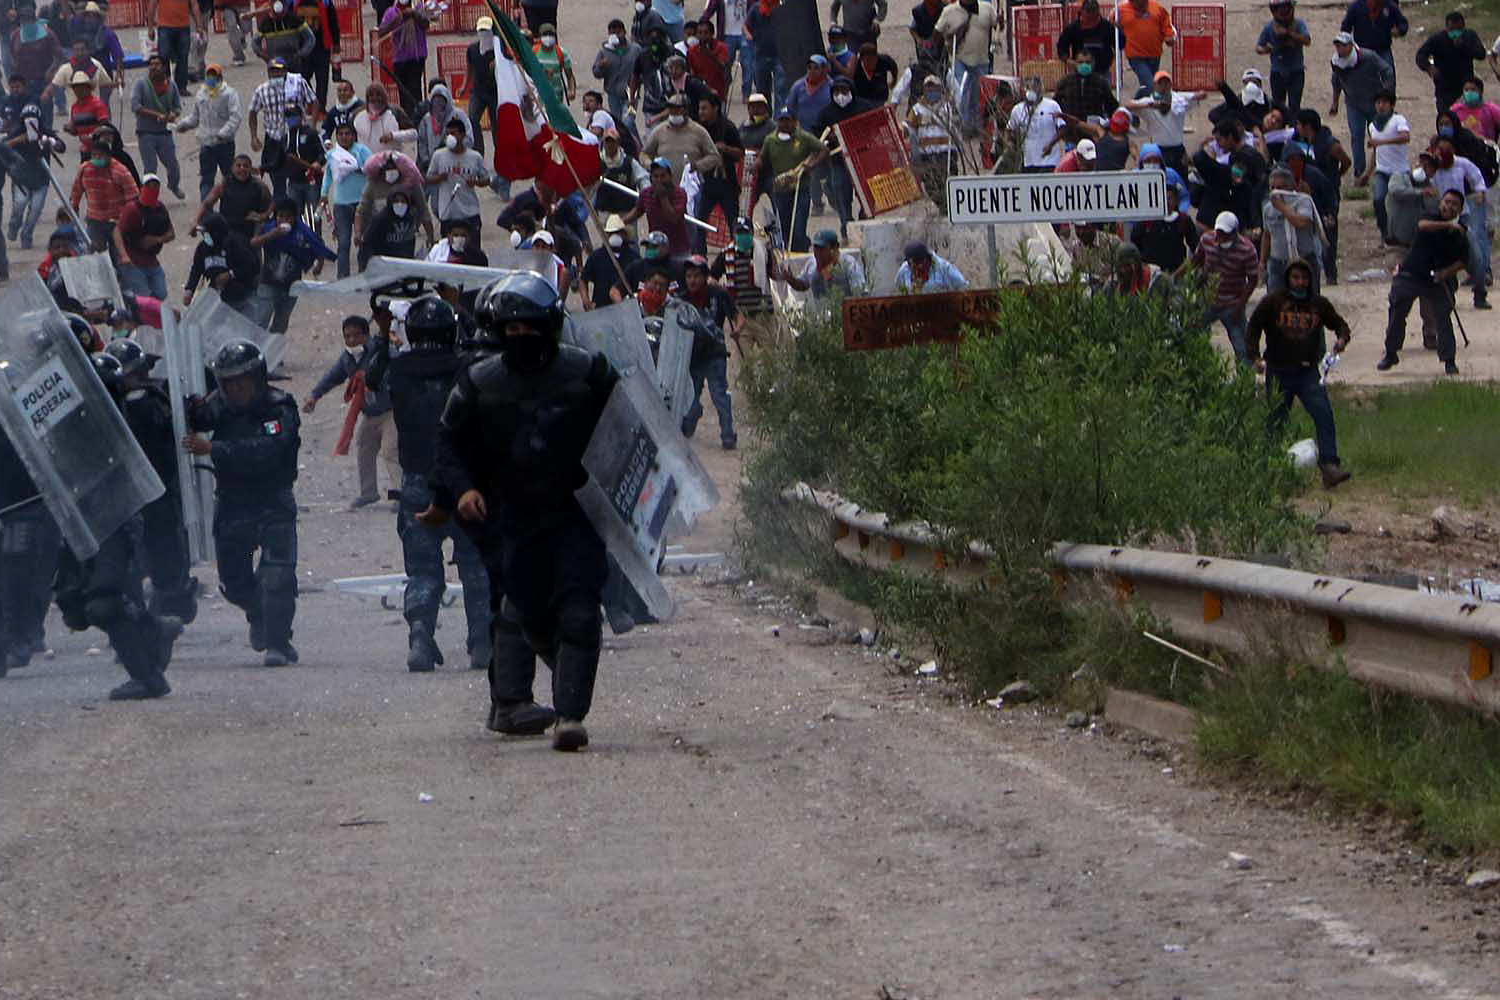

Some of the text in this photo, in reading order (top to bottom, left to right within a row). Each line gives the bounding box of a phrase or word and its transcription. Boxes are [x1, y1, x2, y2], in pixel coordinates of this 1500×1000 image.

[955, 182, 1159, 214] PUENTE NOCHIXTLAN II
[21, 371, 63, 411] POLICIA
[30, 387, 71, 428] FEDERAL
